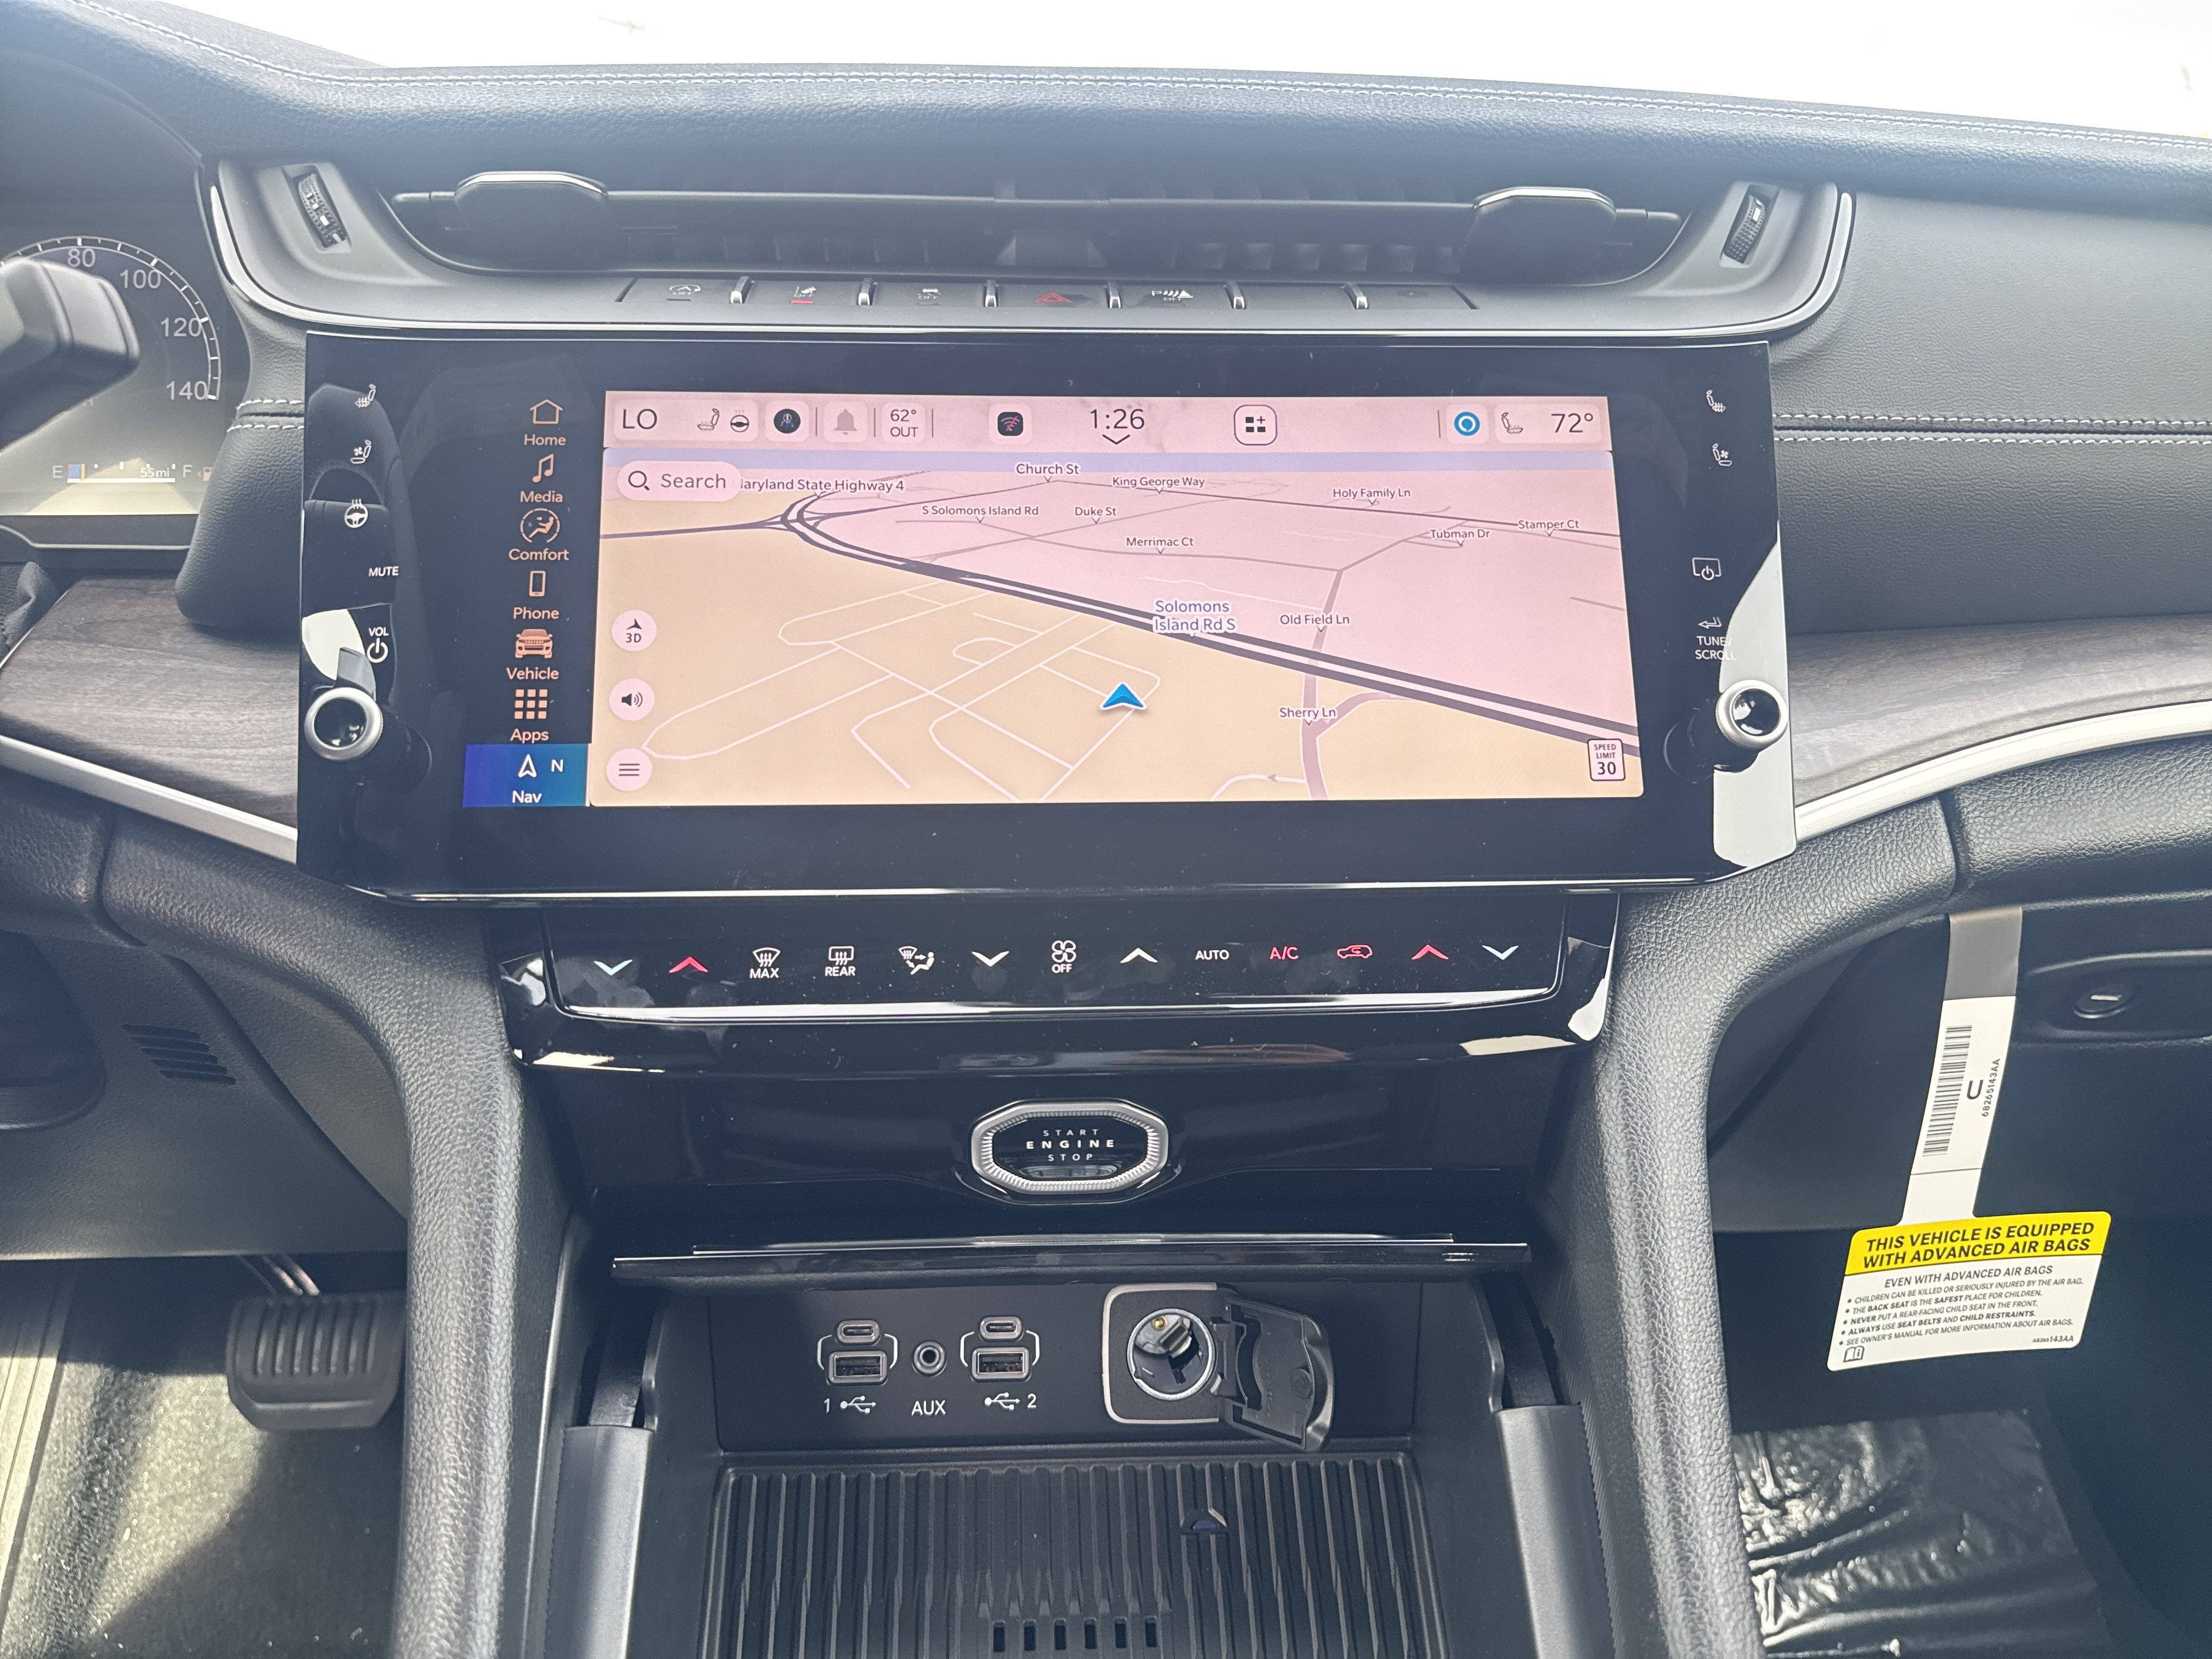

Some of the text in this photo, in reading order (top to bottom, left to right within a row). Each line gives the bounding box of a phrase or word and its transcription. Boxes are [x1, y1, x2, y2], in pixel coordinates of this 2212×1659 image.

[67, 249, 95, 268] 80
[120, 269, 161, 289] 100
[161, 318, 201, 337] 120
[167, 381, 207, 400] 140
[622, 409, 658, 430] LO
[889, 409, 917, 422] 62°
[1090, 409, 1145, 430] 1:26
[1551, 413, 1594, 433] 72°
[890, 427, 918, 437] OUT
[524, 434, 566, 446] Home
[53, 465, 193, 478] E 55mi F
[1016, 464, 1079, 475] Church St
[661, 474, 726, 488] Search
[798, 479, 832, 489] State
[836, 480, 893, 493] Highway
[895, 481, 903, 491] 4
[1113, 477, 1205, 488] King George Way
[520, 491, 563, 503] Media
[1333, 488, 1410, 500] Holy Family Ln
[922, 505, 1039, 515] S Solomons Island Rd
[1075, 507, 1116, 516] Duke St
[1519, 520, 1579, 531] Stamper Ct
[1430, 529, 1490, 539] Tubman Dr
[1126, 537, 1194, 547] Merrimac Ct
[509, 549, 569, 561] Comfort
[369, 566, 399, 577] MUTE
[514, 608, 559, 619] Phone
[1156, 601, 1229, 613] Solomons
[1155, 618, 1235, 630] Island Rd S
[1280, 614, 1350, 624] Old Field Ln
[369, 628, 389, 636] VOL
[625, 633, 641, 643] 3D
[1695, 650, 1736, 661] SCROLL
[506, 668, 559, 680] Vehicle
[1280, 707, 1336, 720] Sherry Ln
[510, 729, 549, 743] Apps
[551, 759, 563, 772] N
[1598, 761, 1616, 775] 30
[512, 791, 542, 804] Nav
[1195, 950, 1229, 960] AUTO
[1269, 946, 1299, 960] A/C
[749, 968, 779, 979] MAX
[825, 966, 855, 977] REAR
[1052, 964, 1072, 973] OFF
[1967, 1080, 1983, 1099] U
[1981, 1059, 2000, 1117] 68265143AA
[1026, 1139, 1114, 1149] ENGINE
[1866, 1222, 2094, 1251] THIS VEHICLE IS EQUIPPED
[1863, 1238, 2091, 1268] WITH ADVANCED AIR BAGS
[1884, 1265, 2053, 1288] EVEN WITH ADVANCED AIR BAGS
[1855, 1293, 1889, 1304] CHILDREN
[1918, 1286, 1942, 1295] KILLED
[1955, 1283, 1994, 1293] SERIOUSLY
[1995, 1280, 2025, 1289] INJURED
[1867, 1303, 1888, 1312] BACK
[1890, 1301, 1910, 1309] SEAT
[1934, 1295, 1963, 1304] SAFEST
[1965, 1293, 1987, 1301] PLACE
[2004, 1290, 2042, 1298] CHILDREN.
[1850, 1316, 1876, 1325] NEVER
[1877, 1313, 1892, 1321] PUT
[1899, 1307, 1944, 1318] REAR-FACING
[1946, 1305, 1967, 1313] CHILD
[1848, 1325, 1881, 1336] ALWAYS
[1897, 1320, 1917, 1328] SEAT
[1918, 1318, 1941, 1326] BELTS
[1986, 1311, 2036, 1319] RESTRAINTS.
[1861, 1333, 1892, 1344] OWNER'S
[1894, 1330, 1923, 1339] MANUAL
[1940, 1325, 1961, 1334] MORE
[1962, 1321, 2011, 1331] INFORMATION
[2013, 1320, 2038, 1328] ABOUT
[823, 1399, 830, 1413] 1
[1028, 1393, 1037, 1408] 2
[912, 1401, 946, 1415] AUX
